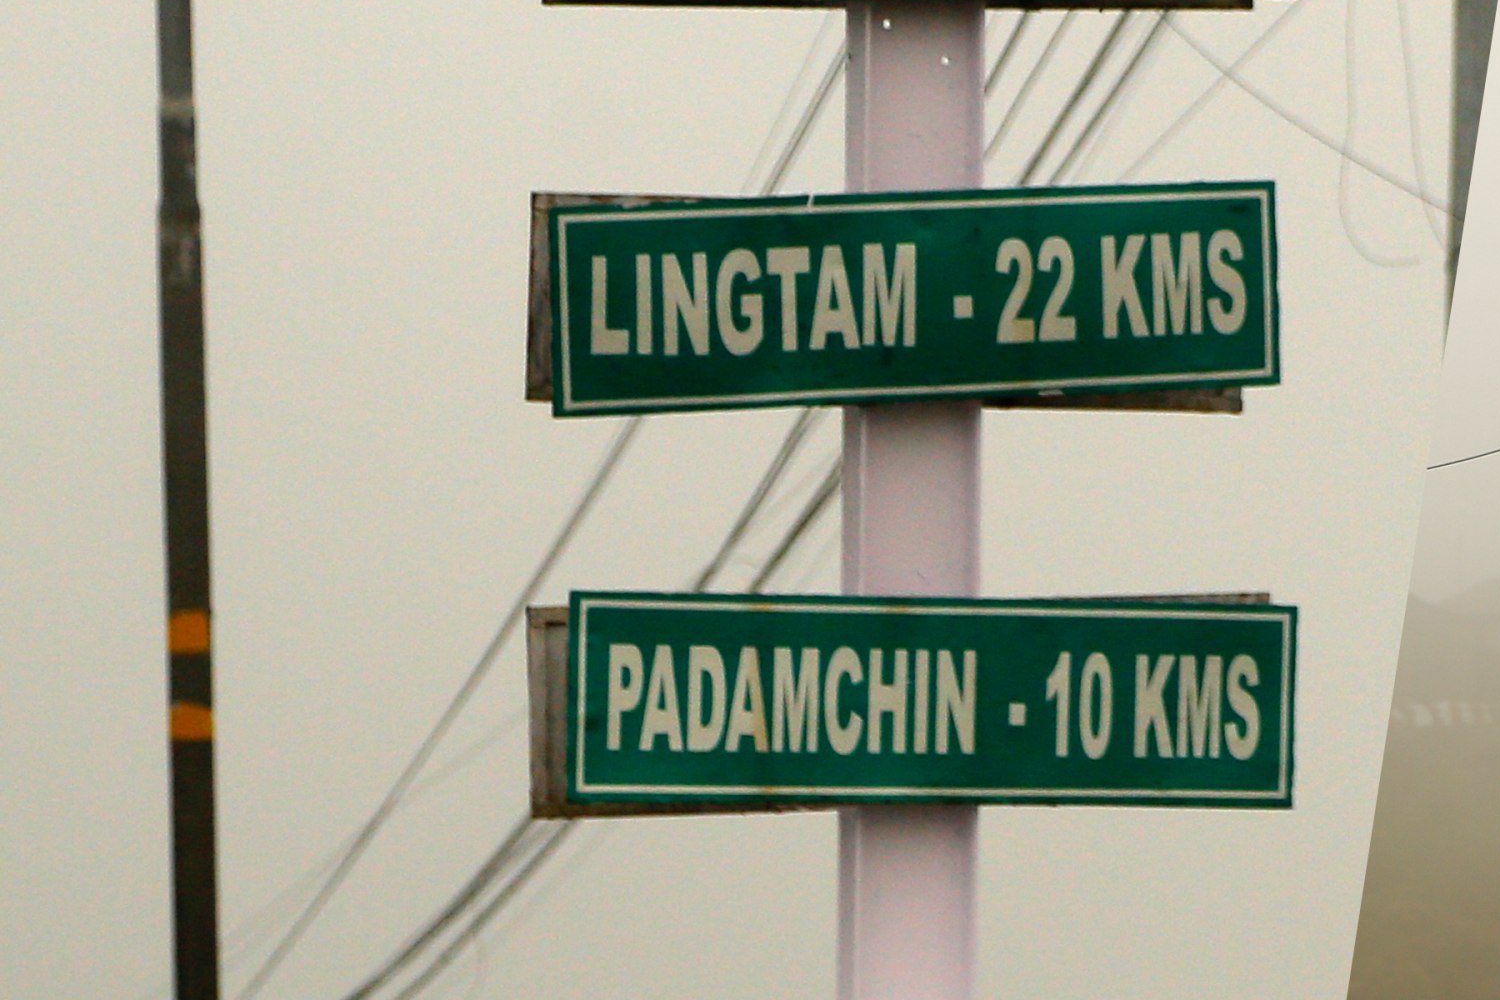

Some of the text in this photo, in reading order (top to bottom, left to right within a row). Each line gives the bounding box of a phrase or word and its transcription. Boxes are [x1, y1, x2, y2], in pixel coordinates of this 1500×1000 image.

[590, 229, 1247, 356] LINGTAM - 22 KMS
[606, 643, 1260, 761] PADAMCHIN - 10 KMS
